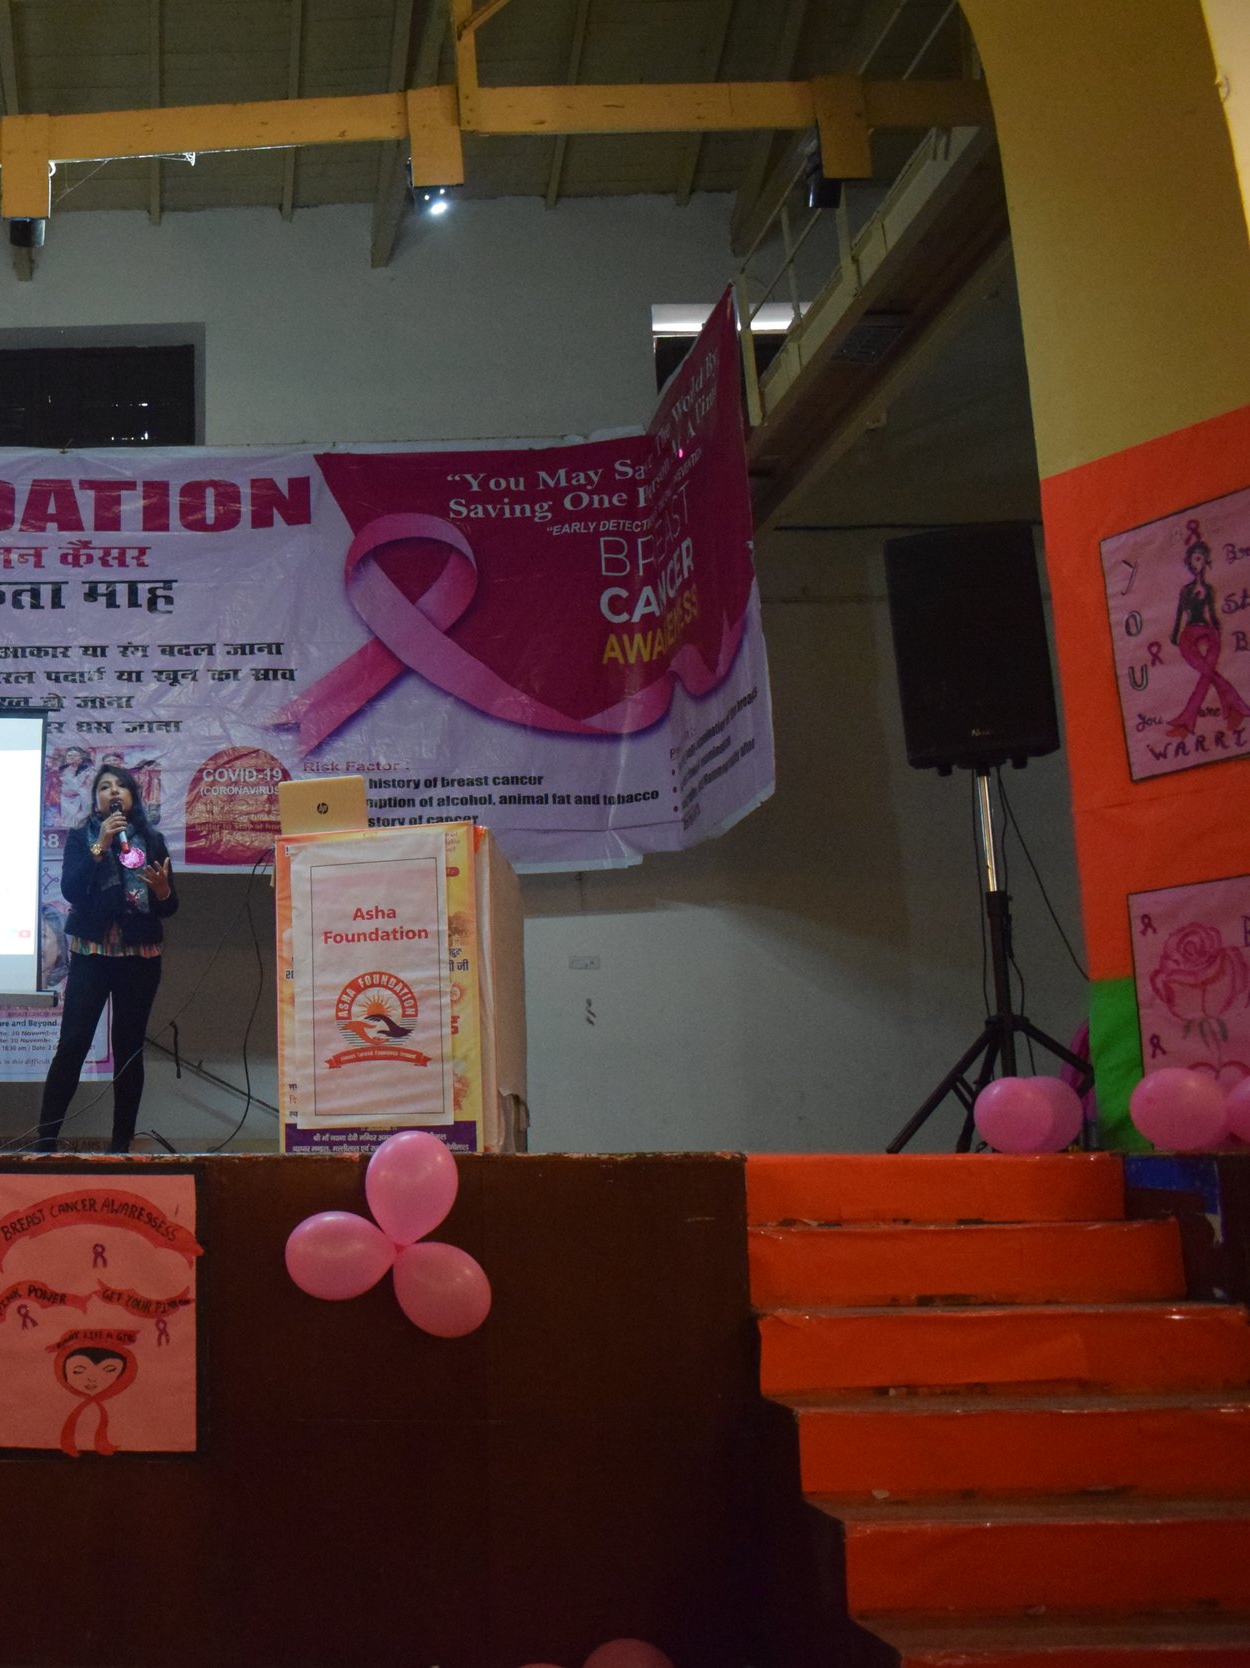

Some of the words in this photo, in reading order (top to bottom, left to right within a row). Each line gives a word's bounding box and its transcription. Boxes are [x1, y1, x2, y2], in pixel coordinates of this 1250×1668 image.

[535, 467, 604, 490] May
[448, 497, 553, 523] Saving
[563, 491, 628, 511] One
[600, 536, 694, 624] CANCER
[81, 579, 178, 614] माह
[79, 645, 109, 658] या
[114, 670, 144, 683] या
[202, 768, 283, 782] COVID-19
[368, 777, 421, 790] history
[423, 776, 438, 788] of
[440, 775, 489, 788] breast
[492, 775, 544, 786] cancer
[419, 796, 434, 807] of
[437, 793, 496, 807] alcohol,
[499, 793, 549, 805] animal
[552, 793, 572, 805] fat
[574, 793, 600, 805] and
[602, 790, 659, 806] tobacco
[352, 905, 397, 921] Asha
[323, 926, 429, 944] Foundation
[337, 988, 356, 1018] ASHA
[358, 974, 416, 1015] FOUNDATION
[11, 1019, 27, 1028] and
[0, 1208, 46, 1242] BREAST
[50, 1198, 98, 1219] CANCER
[27, 1284, 68, 1305] POWER
